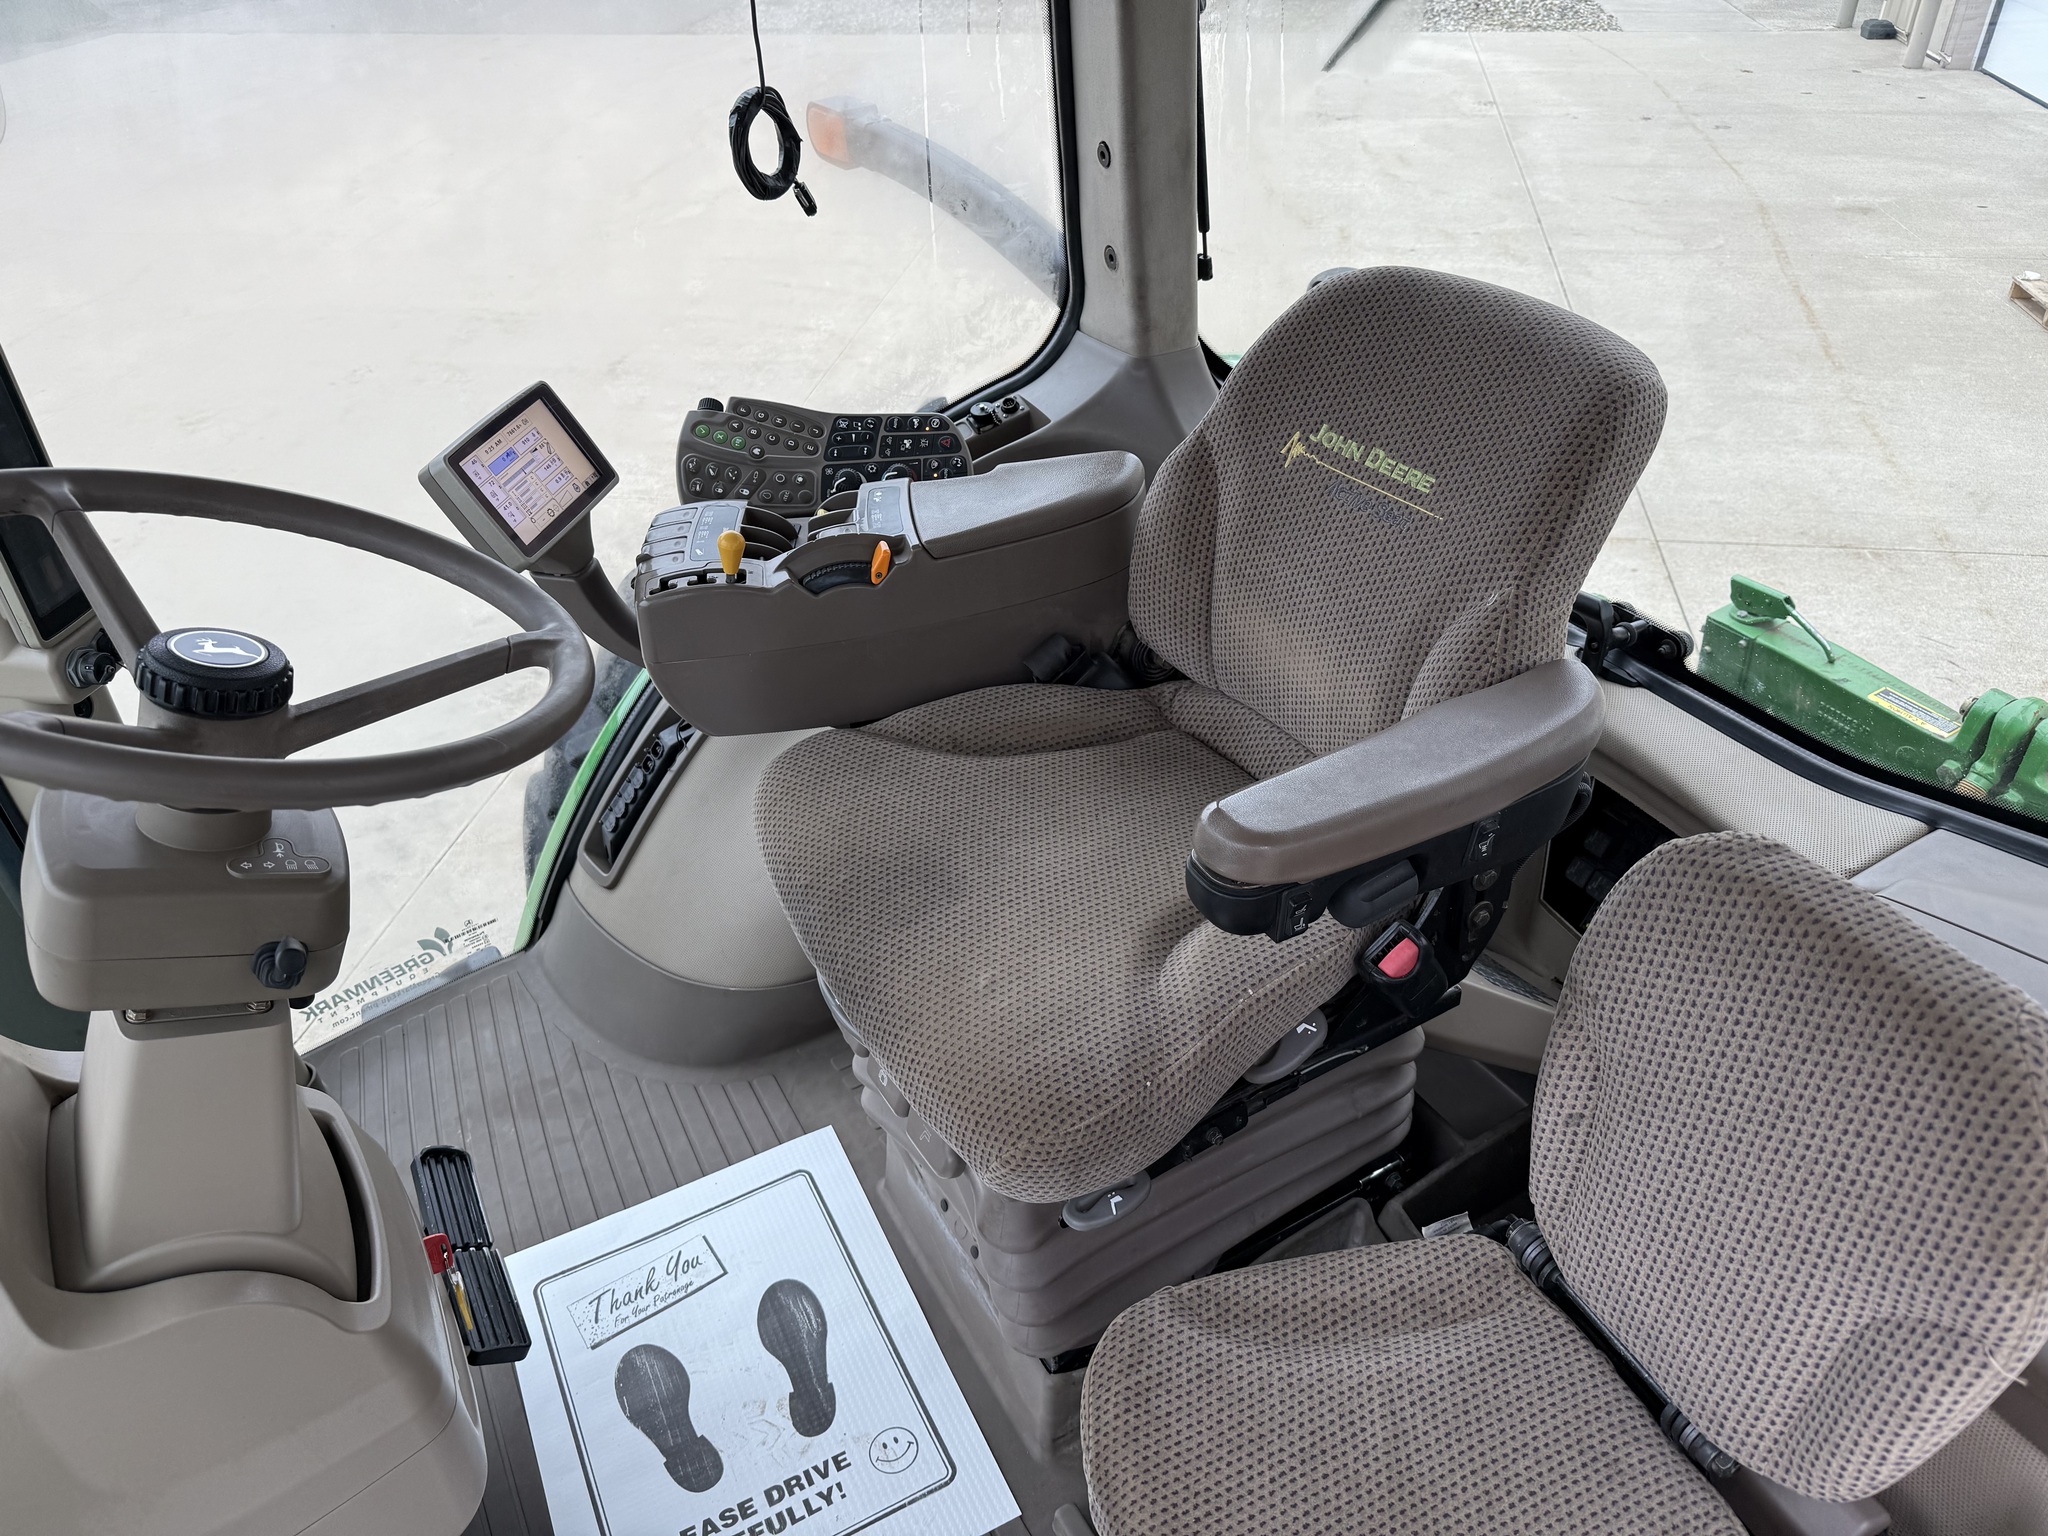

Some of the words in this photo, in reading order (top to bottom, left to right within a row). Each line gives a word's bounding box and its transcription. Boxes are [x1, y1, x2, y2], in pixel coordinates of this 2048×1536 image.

[1309, 424, 1365, 462] JOHN
[1364, 446, 1436, 494] DEERE
[1324, 479, 1374, 513] Active
[1373, 500, 1415, 533] Seat
[588, 1266, 660, 1324] Thank
[665, 1250, 703, 1282] You
[614, 1313, 629, 1328] For
[631, 1303, 651, 1318] Your
[653, 1280, 694, 1307] Patronage
[763, 1450, 852, 1508] DRIVE
[731, 1481, 847, 1536] FULLY!
